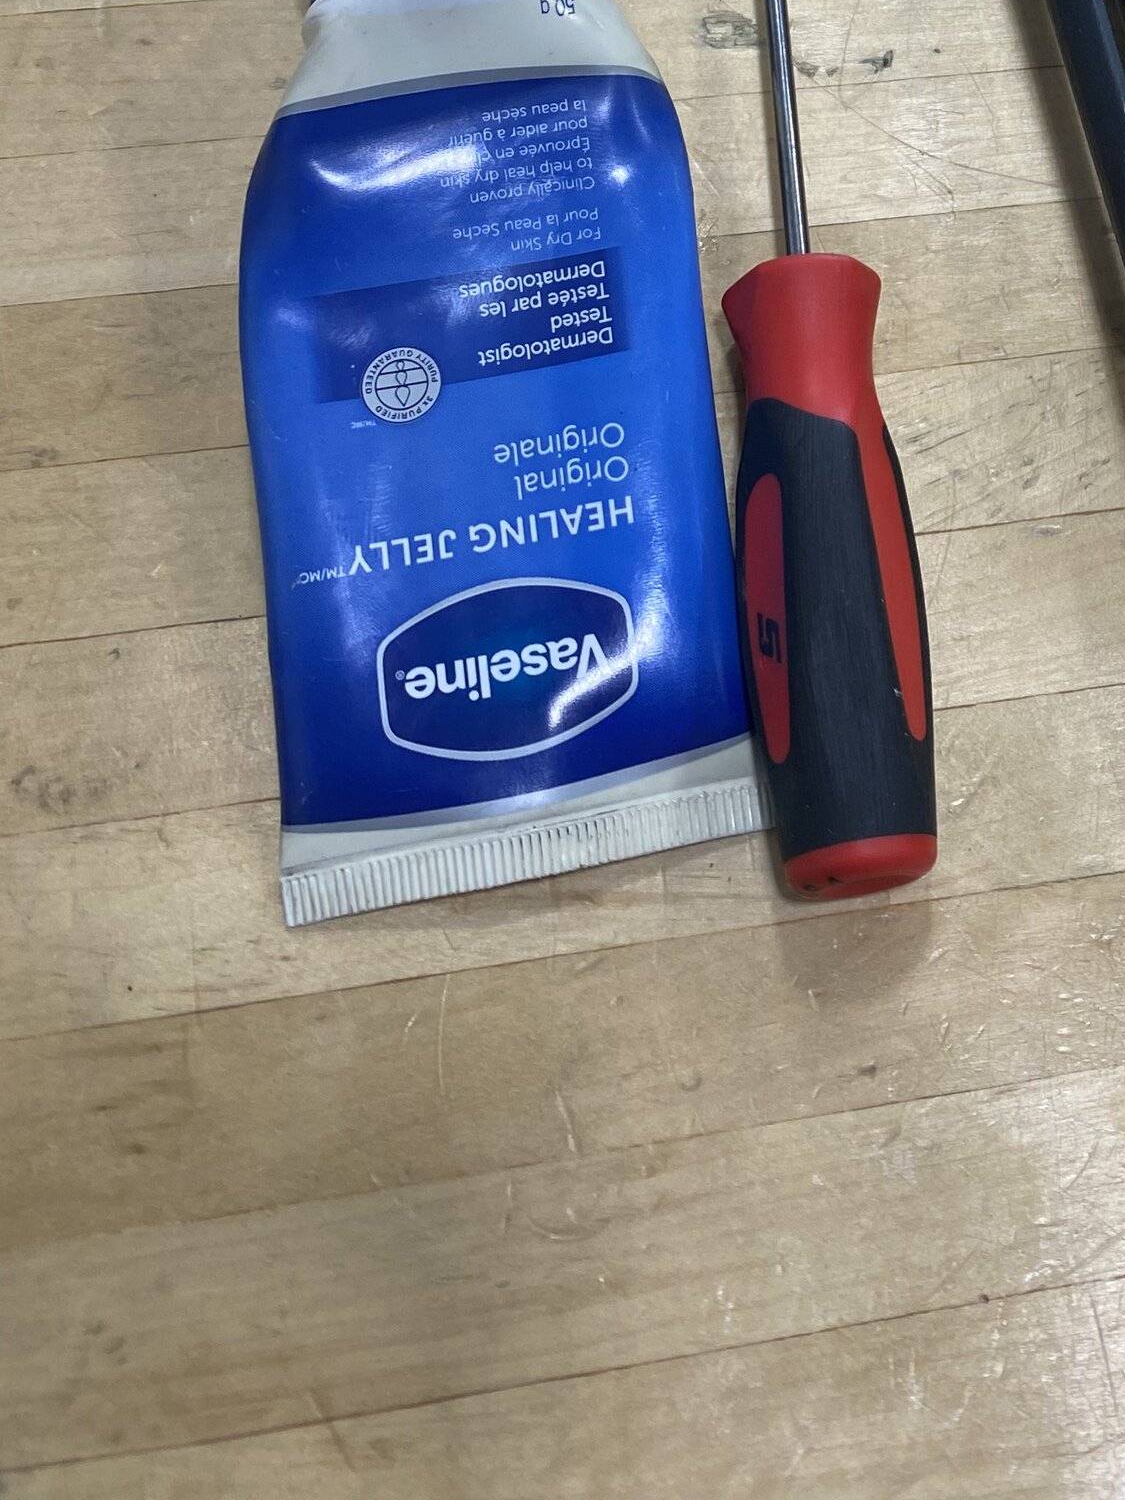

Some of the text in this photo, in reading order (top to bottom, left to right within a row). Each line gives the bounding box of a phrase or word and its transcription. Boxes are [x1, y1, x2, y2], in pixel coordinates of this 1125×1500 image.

[531, 98, 568, 116] peau
[572, 99, 586, 111] la
[509, 122, 548, 138] aider
[553, 116, 588, 132] pour
[495, 147, 514, 160] en
[519, 134, 591, 158] Éprouvée
[440, 156, 593, 189] to help heal dry skin
[469, 176, 595, 204] Clinically proven
[504, 215, 542, 234] Peau
[546, 211, 560, 228] la
[563, 207, 599, 225] Pour
[510, 226, 601, 254] For Dry Skin
[458, 260, 605, 300] Dermatologues
[479, 282, 609, 319] Testée par les
[550, 305, 612, 332] Tested
[477, 326, 613, 366] Dermatologist
[365, 350, 438, 395] PURITY GUARANTEED
[375, 405, 421, 420] PURIFIED
[493, 423, 625, 465] Originale
[514, 456, 629, 499] Original
[468, 495, 634, 553] HEALING
[347, 529, 457, 576] JELLY
[404, 633, 609, 701] Vaseline
